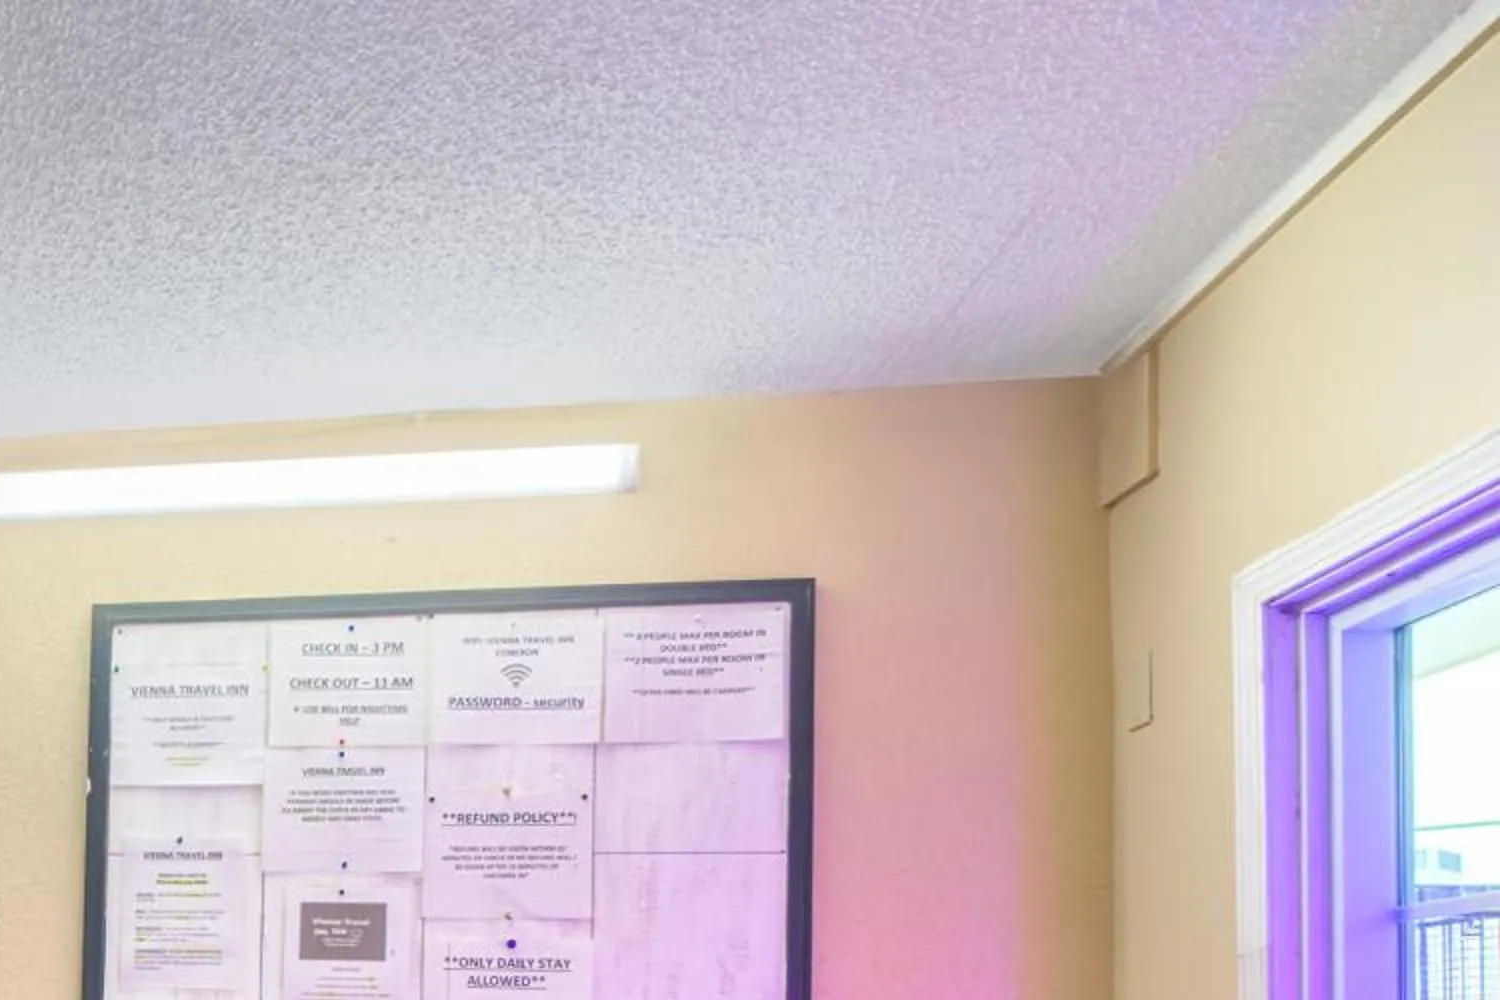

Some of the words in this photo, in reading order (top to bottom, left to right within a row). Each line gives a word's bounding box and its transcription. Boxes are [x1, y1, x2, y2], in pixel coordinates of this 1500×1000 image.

[301, 642, 341, 655] CHECK
[345, 642, 359, 655] IN
[371, 642, 380, 654] 3
[382, 641, 405, 654] PM
[289, 677, 329, 690] CHECK
[332, 677, 360, 690] OUT
[374, 677, 388, 690] 11
[391, 676, 414, 689] AM
[131, 685, 176, 698] VIENNA
[179, 685, 223, 698] TRAVEL
[226, 684, 250, 697] INN
[449, 696, 522, 709] PASSWORD
[533, 697, 585, 710] security
[301, 766, 335, 777] VIENNA
[497, 957, 535, 969] DAILY
[537, 958, 572, 969] STAY
